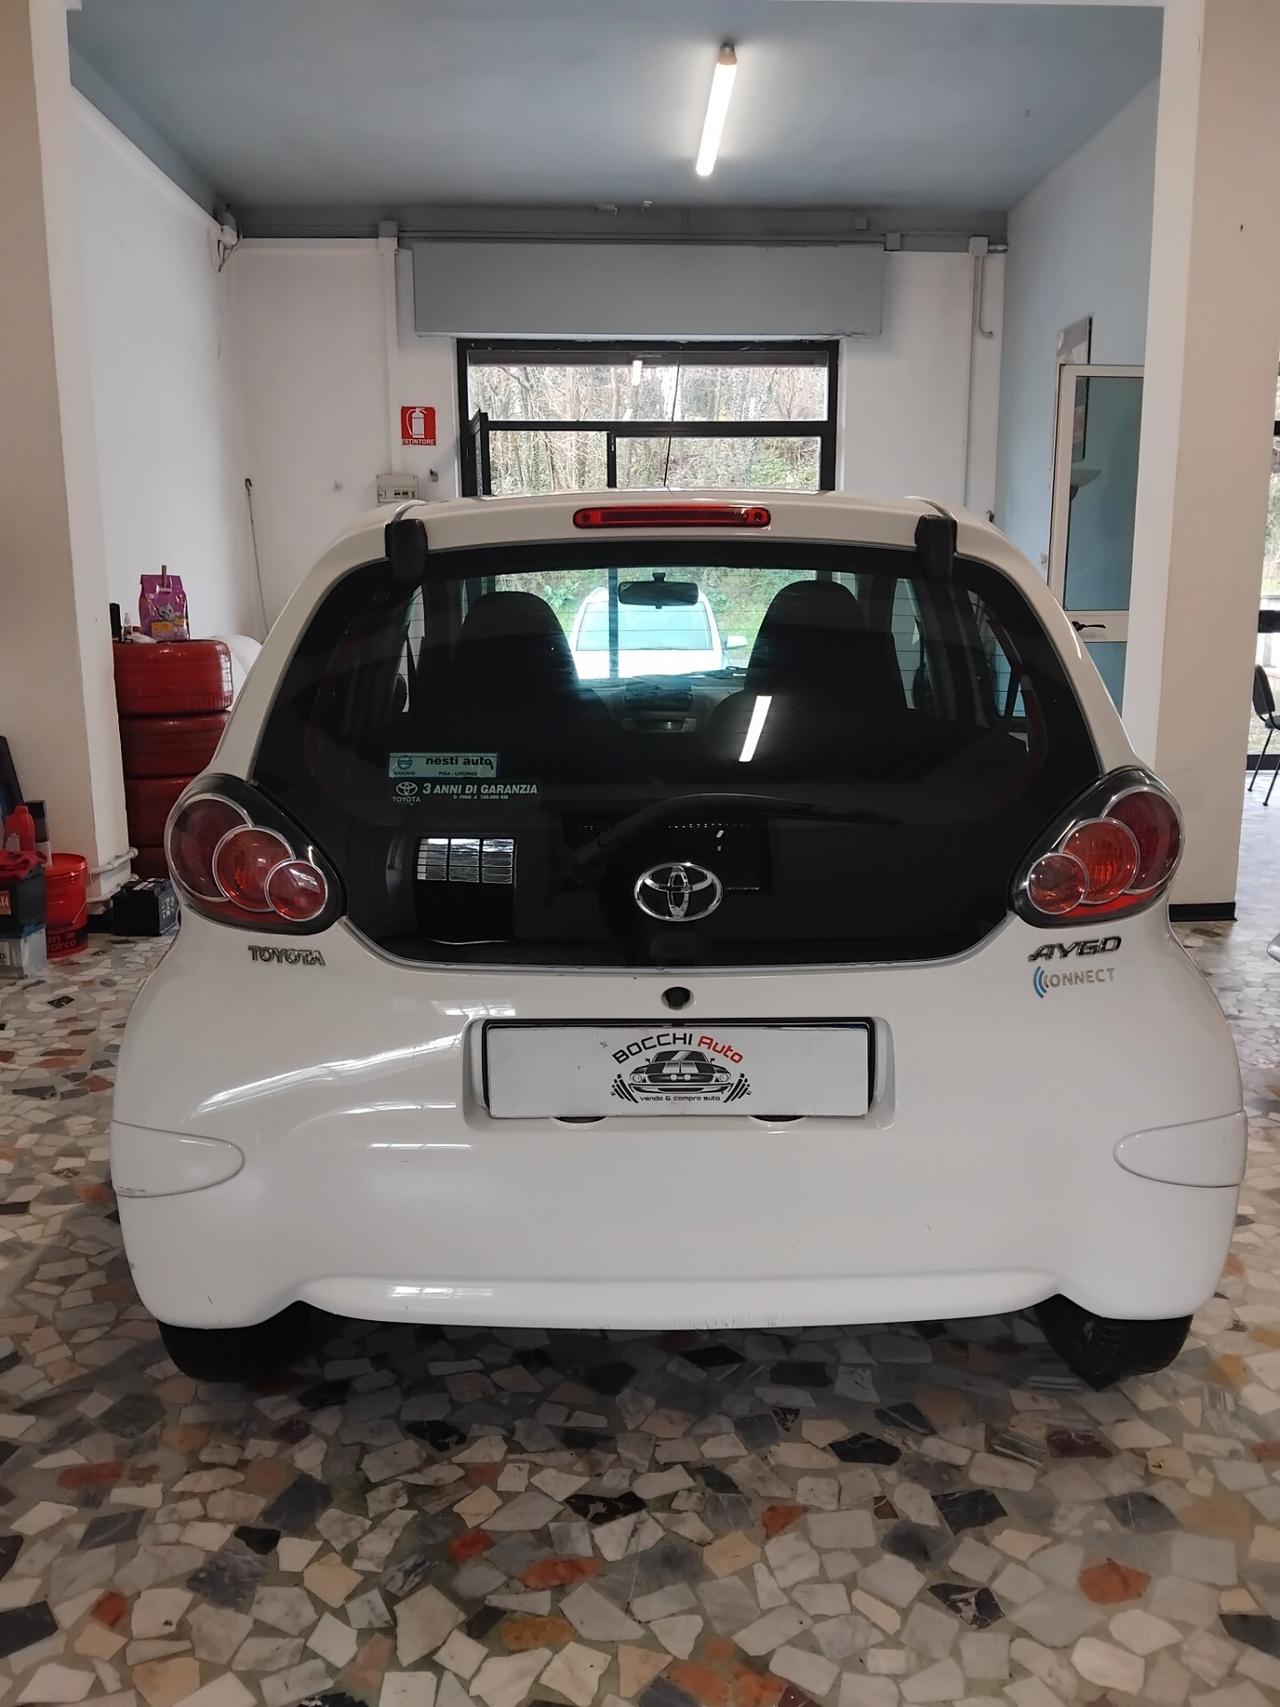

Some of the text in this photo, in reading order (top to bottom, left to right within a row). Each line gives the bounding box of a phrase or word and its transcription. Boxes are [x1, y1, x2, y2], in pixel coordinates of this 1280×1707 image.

[425, 756, 494, 771] nesti auto
[422, 782, 538, 794] 3 ANNI DI GARANZIA
[248, 945, 326, 967] TOYOTA
[1027, 935, 1122, 962] AYGO
[612, 1032, 744, 1064] BOCCHI Auto
